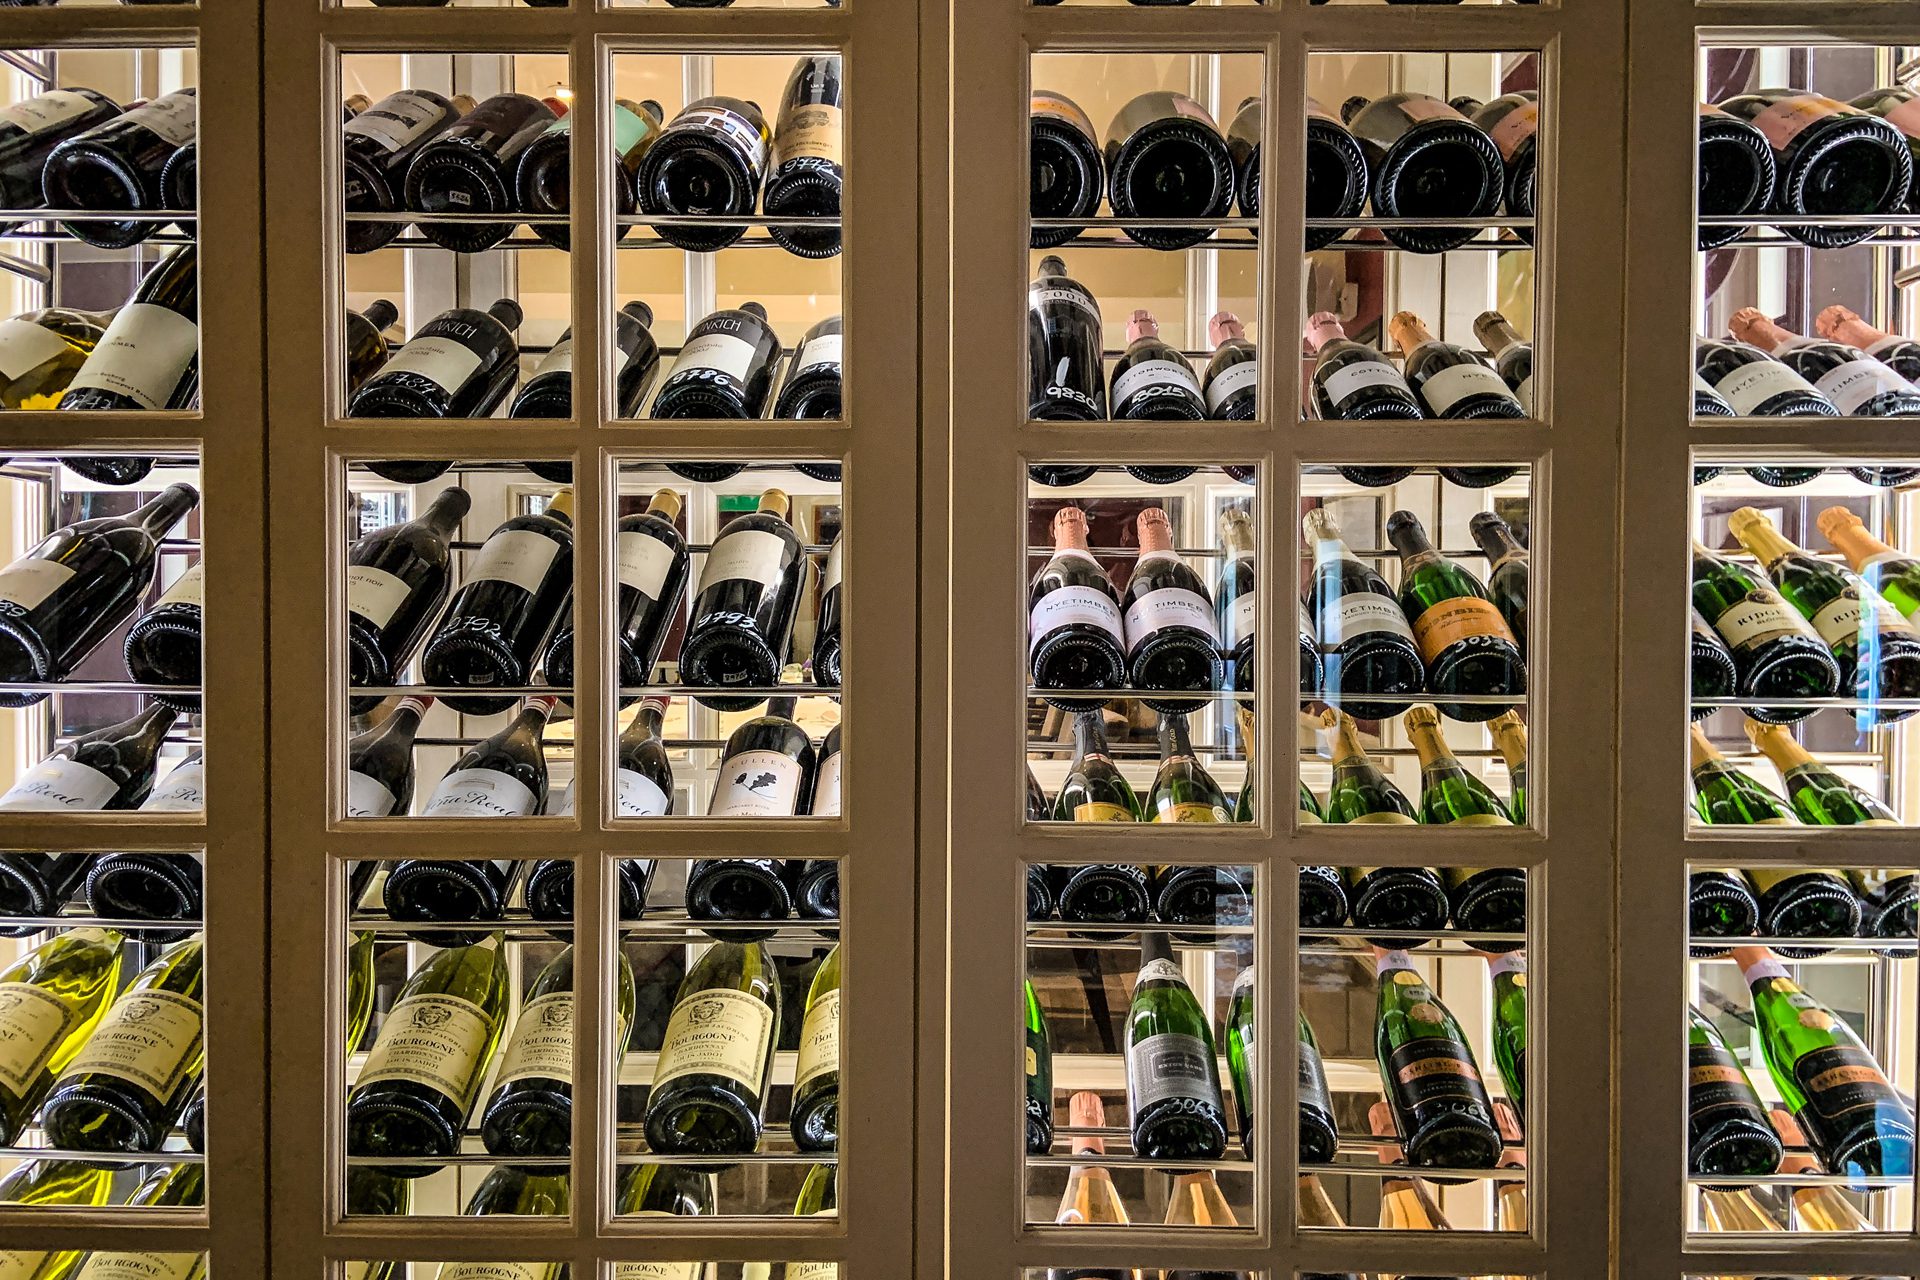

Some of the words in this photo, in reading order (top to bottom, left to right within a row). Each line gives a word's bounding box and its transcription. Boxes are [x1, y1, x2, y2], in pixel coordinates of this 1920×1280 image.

[1042, 290, 1087, 306] 2000
[672, 369, 731, 386] 9786
[1221, 369, 1257, 386] COTTO
[1046, 387, 1098, 410] 9830
[1046, 599, 1116, 619] NYETIMBER
[731, 758, 788, 770] ULLEN
[464, 790, 518, 816] Real
[91, 1032, 158, 1048] BOURGOGNE
[387, 1038, 456, 1056] BOURGOGNE
[434, 1030, 469, 1057] JACOBINS
[519, 1037, 571, 1048] BOURGOG
[671, 1033, 737, 1050] BOURGOGNE
[389, 1050, 442, 1062] CHARDONNAY
[522, 1048, 571, 1056] CHARDONNA
[414, 1059, 439, 1070] JADOT
[93, 1258, 160, 1278] BOURGOGNE
[453, 1266, 521, 1280] BOURGOGNE
[615, 1263, 668, 1276] URGOGNE
